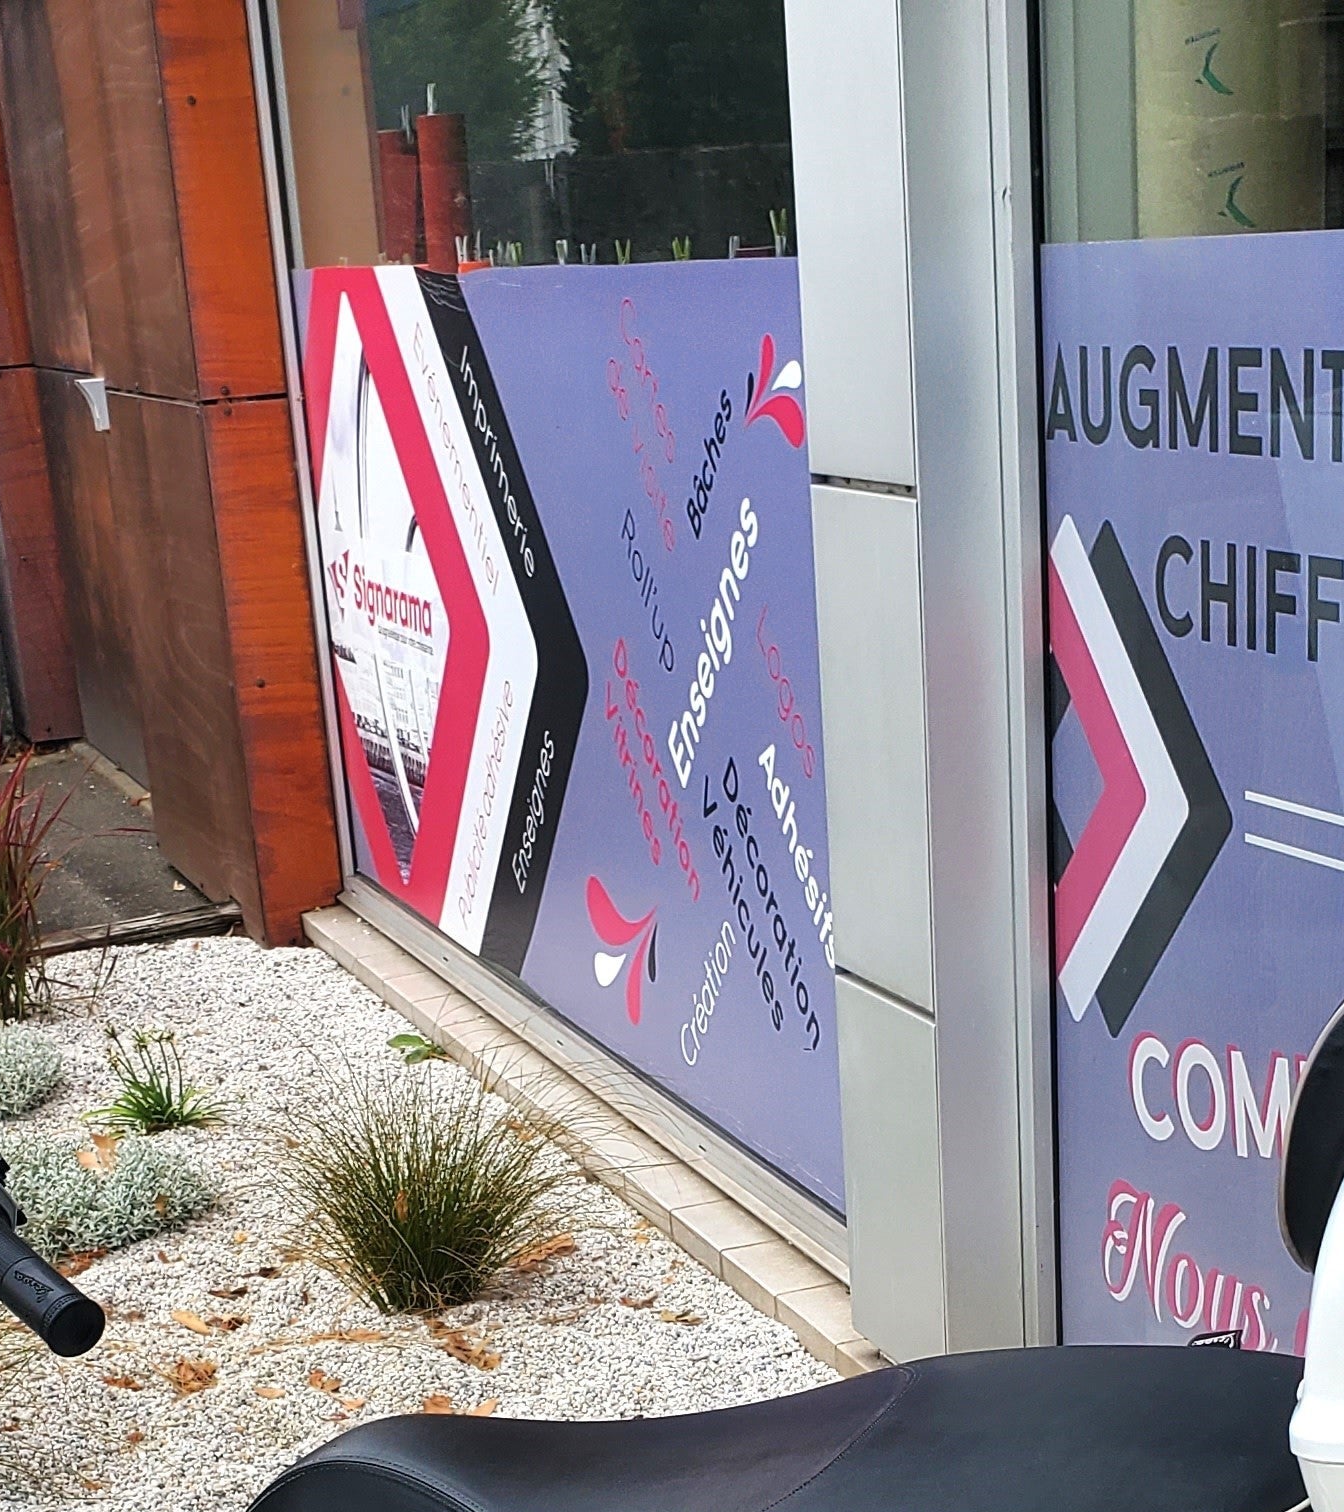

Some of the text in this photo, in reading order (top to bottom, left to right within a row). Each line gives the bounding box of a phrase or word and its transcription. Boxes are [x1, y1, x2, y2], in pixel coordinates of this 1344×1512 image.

[460, 345, 535, 578] Imprimerie
[686, 388, 733, 541] Bâches
[353, 563, 434, 638] Signarama
[667, 496, 759, 789] Enseignes
[614, 636, 701, 902] Décoration
[756, 604, 816, 779] Logos
[511, 730, 555, 895] Enseignes
[701, 774, 784, 1033] Véhicules
[722, 756, 822, 1050] Décoration
[680, 920, 737, 1068] Création
[1128, 1030, 1312, 1160] COM
